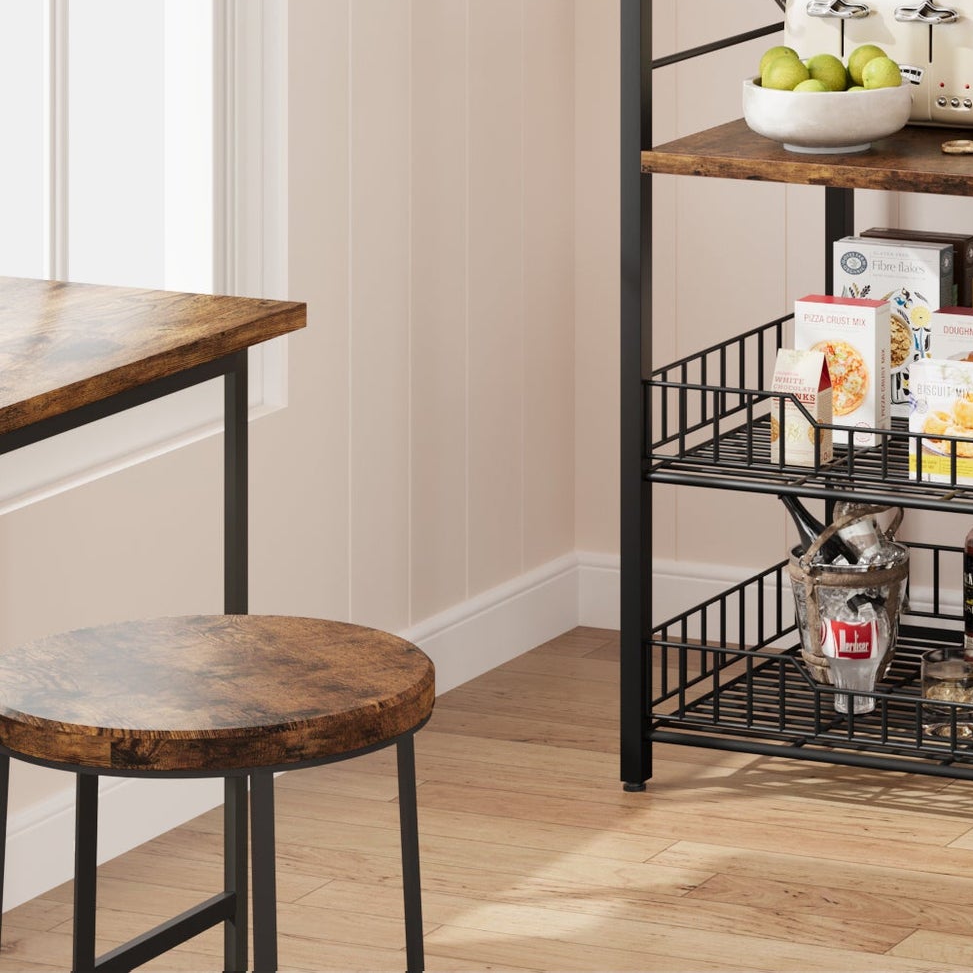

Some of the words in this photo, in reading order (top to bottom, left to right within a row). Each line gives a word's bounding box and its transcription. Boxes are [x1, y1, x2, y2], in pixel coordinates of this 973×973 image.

[872, 260, 896, 271] Fibre
[898, 261, 926, 274] flakes
[804, 313, 824, 323] PIZZA
[826, 315, 850, 325] CRUST
[852, 317, 866, 327] MIX
[775, 376, 804, 384] WHITE
[917, 383, 951, 397] BISCUIT
[955, 387, 970, 399] MIX
